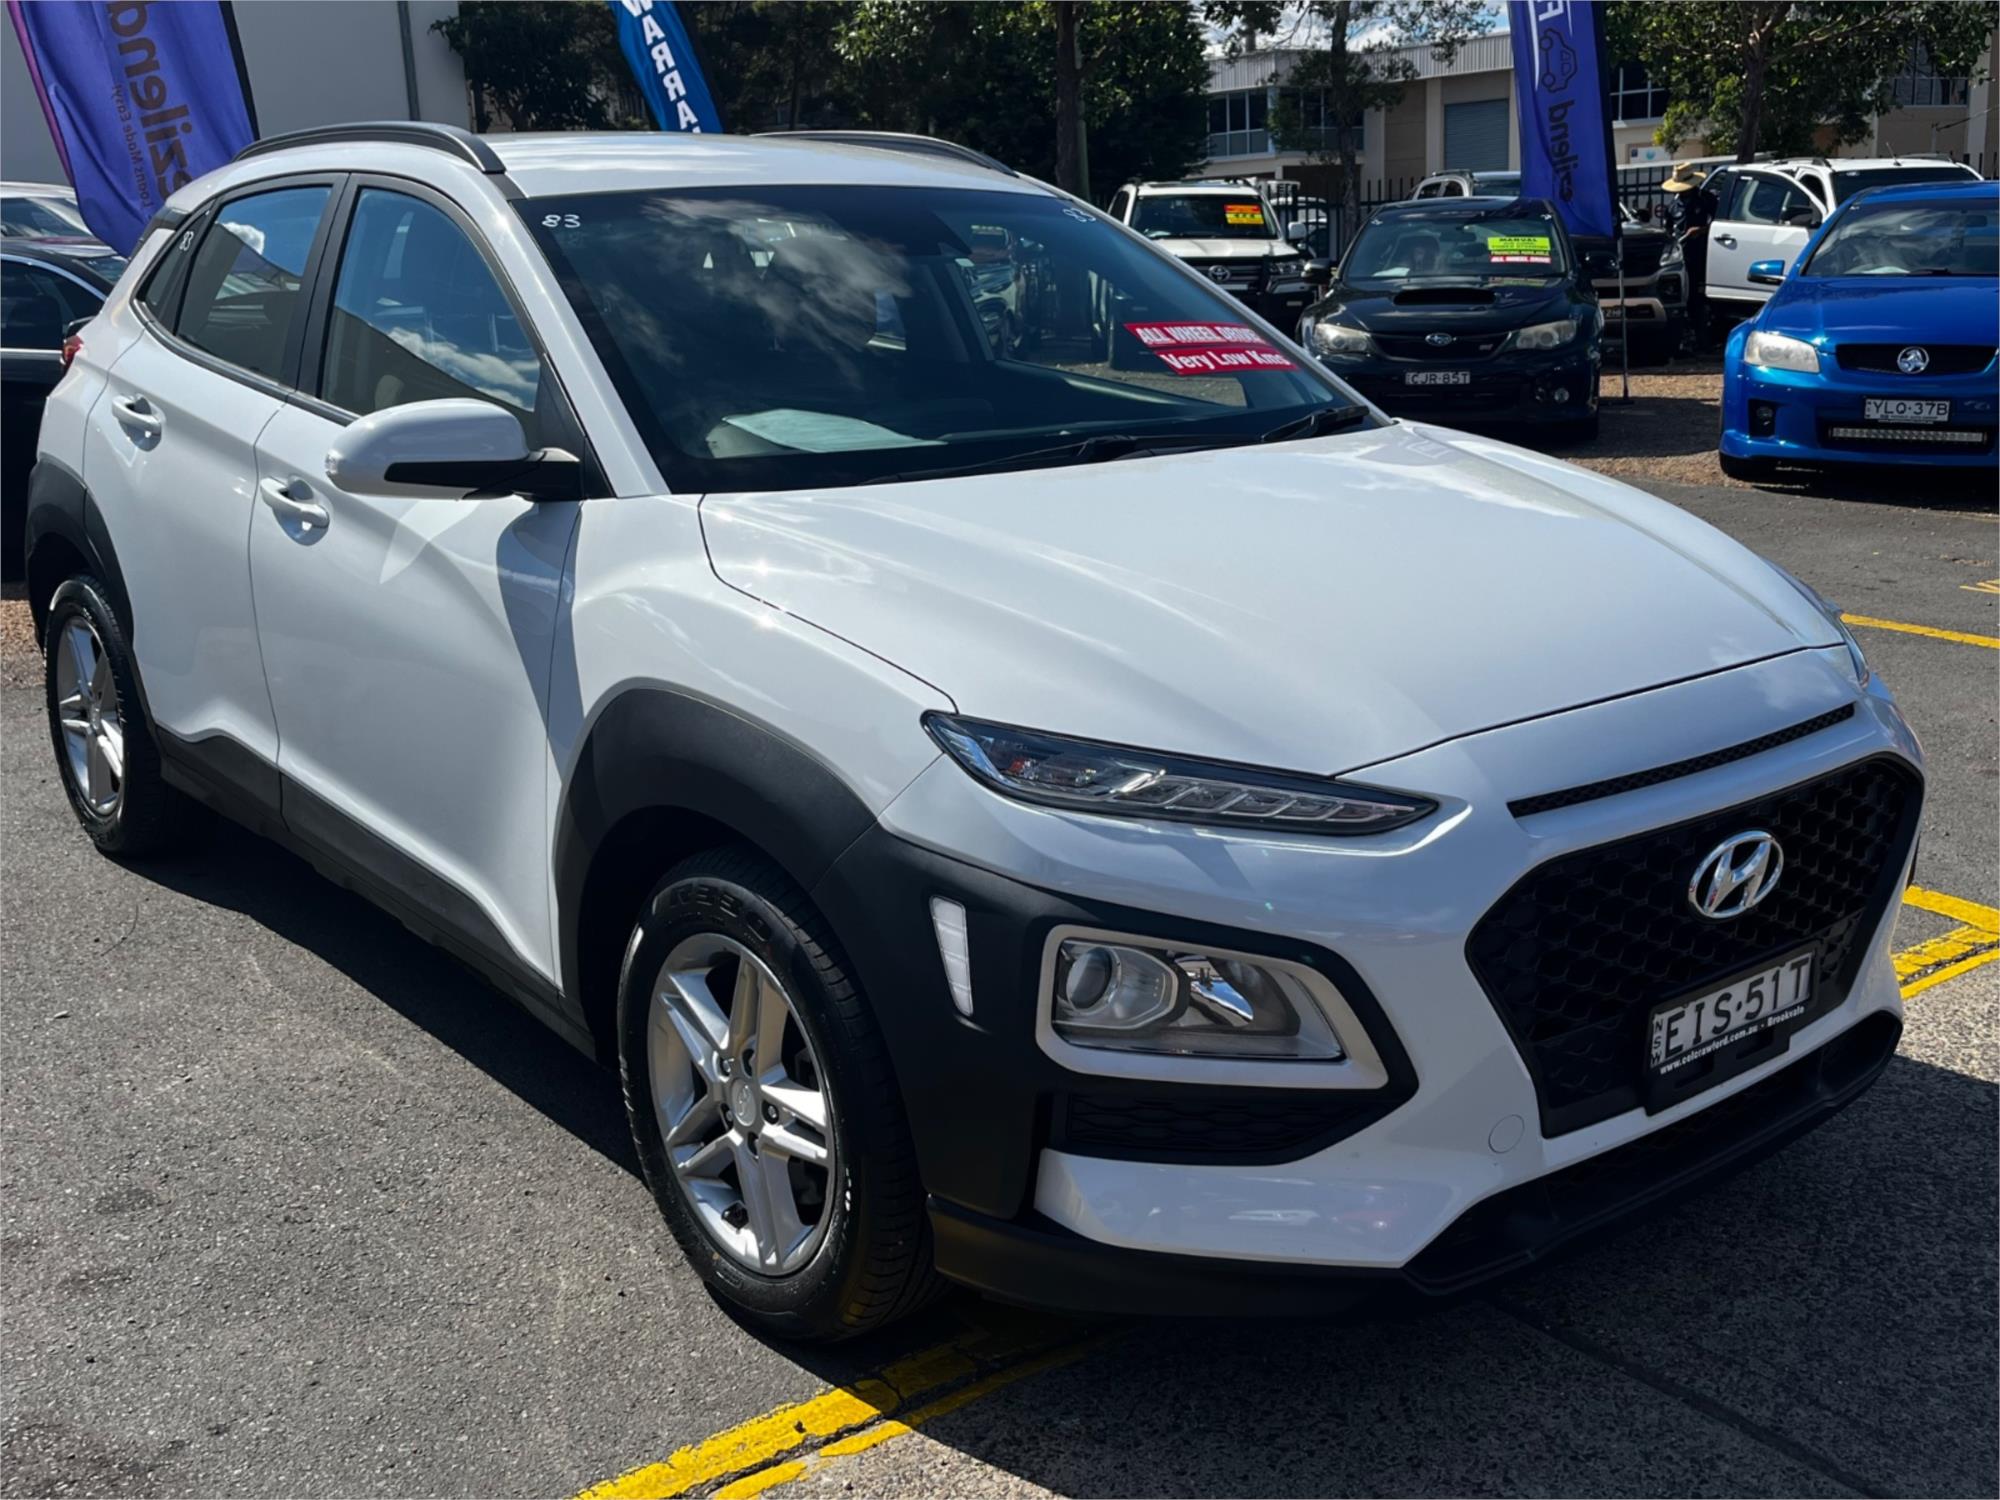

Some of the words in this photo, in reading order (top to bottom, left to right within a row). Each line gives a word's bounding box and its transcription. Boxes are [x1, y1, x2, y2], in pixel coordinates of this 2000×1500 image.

[541, 214, 581, 228] 83
[179, 230, 194, 251] 83
[1135, 326, 1177, 344] ALL
[1163, 325, 1227, 343] WHEEL
[1214, 325, 1266, 344] DRIVE
[1160, 353, 1215, 370] Very
[1206, 350, 1251, 365] Low
[1245, 349, 1291, 365] Kms
[1767, 1005, 1805, 1027] Brookvale
